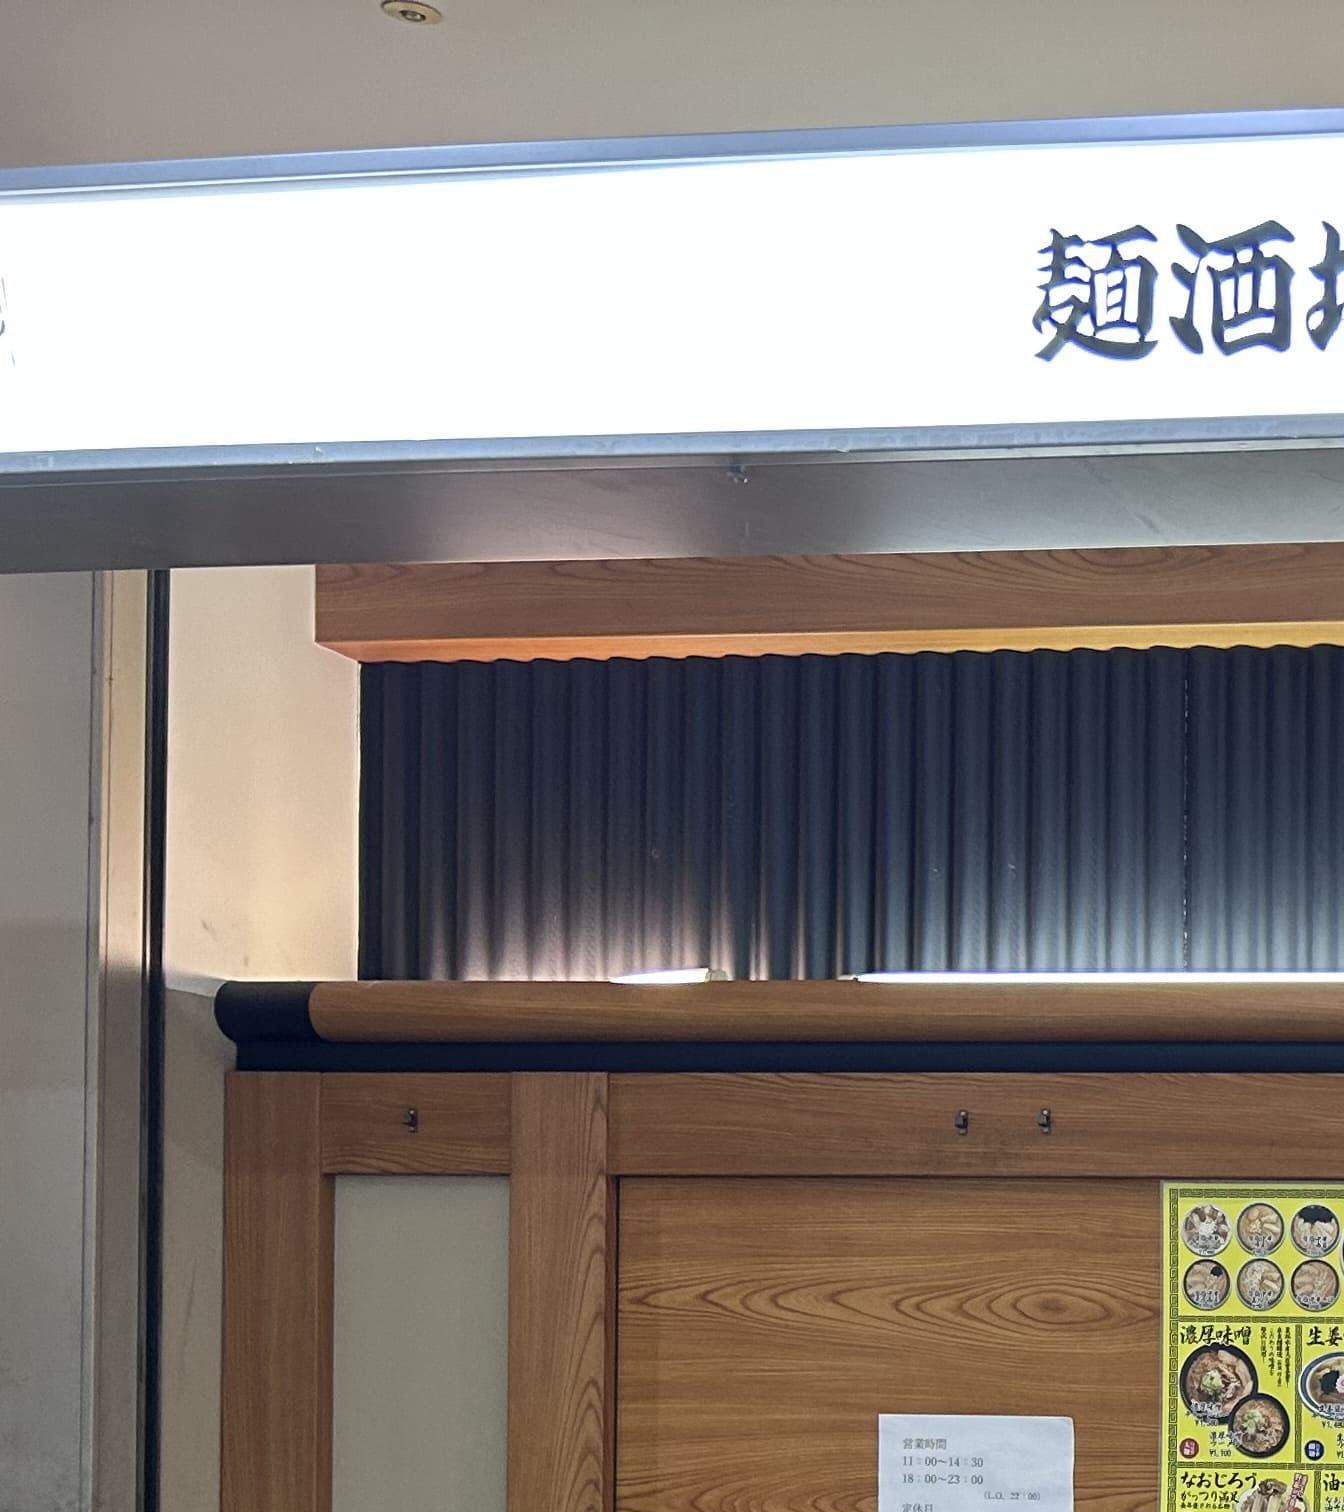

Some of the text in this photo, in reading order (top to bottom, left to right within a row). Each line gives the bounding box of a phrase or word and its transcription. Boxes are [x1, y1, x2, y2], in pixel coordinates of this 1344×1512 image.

[1180, 1325, 1252, 1345] 濃厚味噌
[902, 1438, 947, 1450] 営業時間
